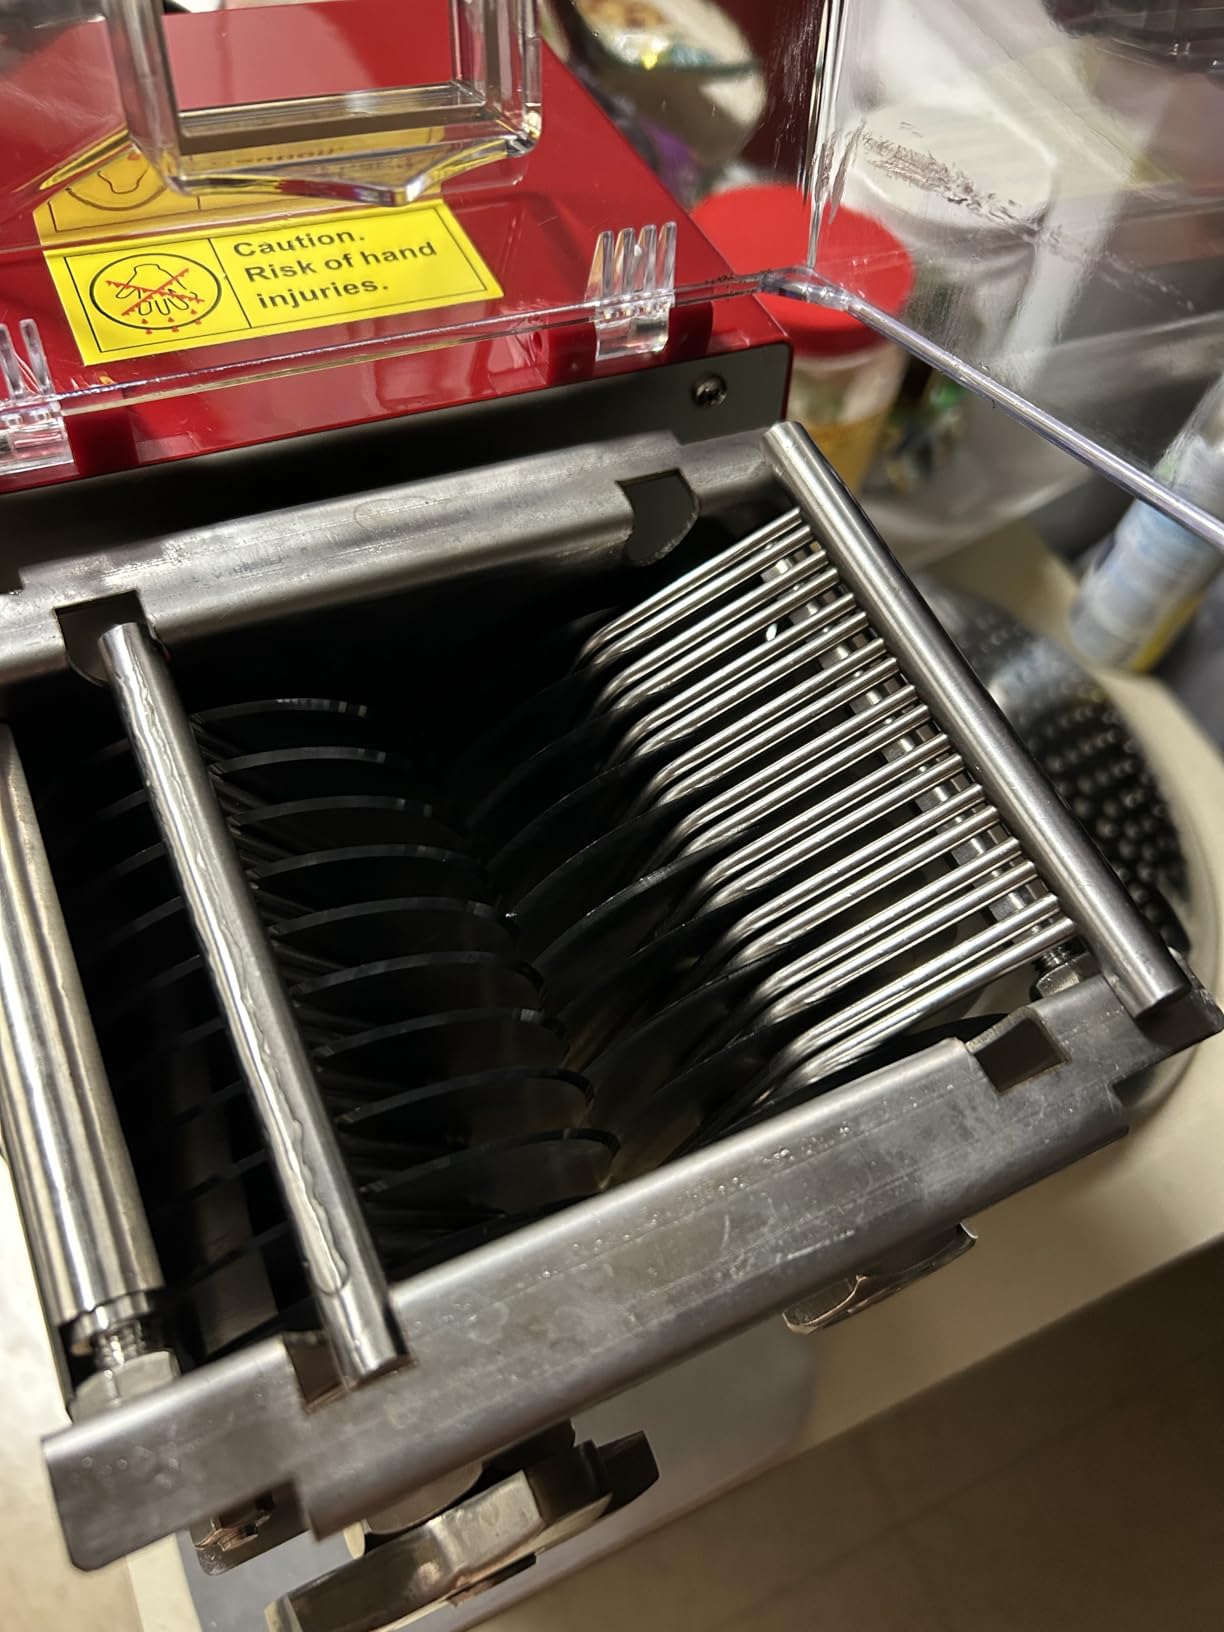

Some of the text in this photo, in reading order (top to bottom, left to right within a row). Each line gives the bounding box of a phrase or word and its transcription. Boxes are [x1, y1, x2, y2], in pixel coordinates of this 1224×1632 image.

[233, 230, 365, 257] Caution.
[244, 241, 437, 283] Risk of hand
[256, 279, 389, 309] injuries.
